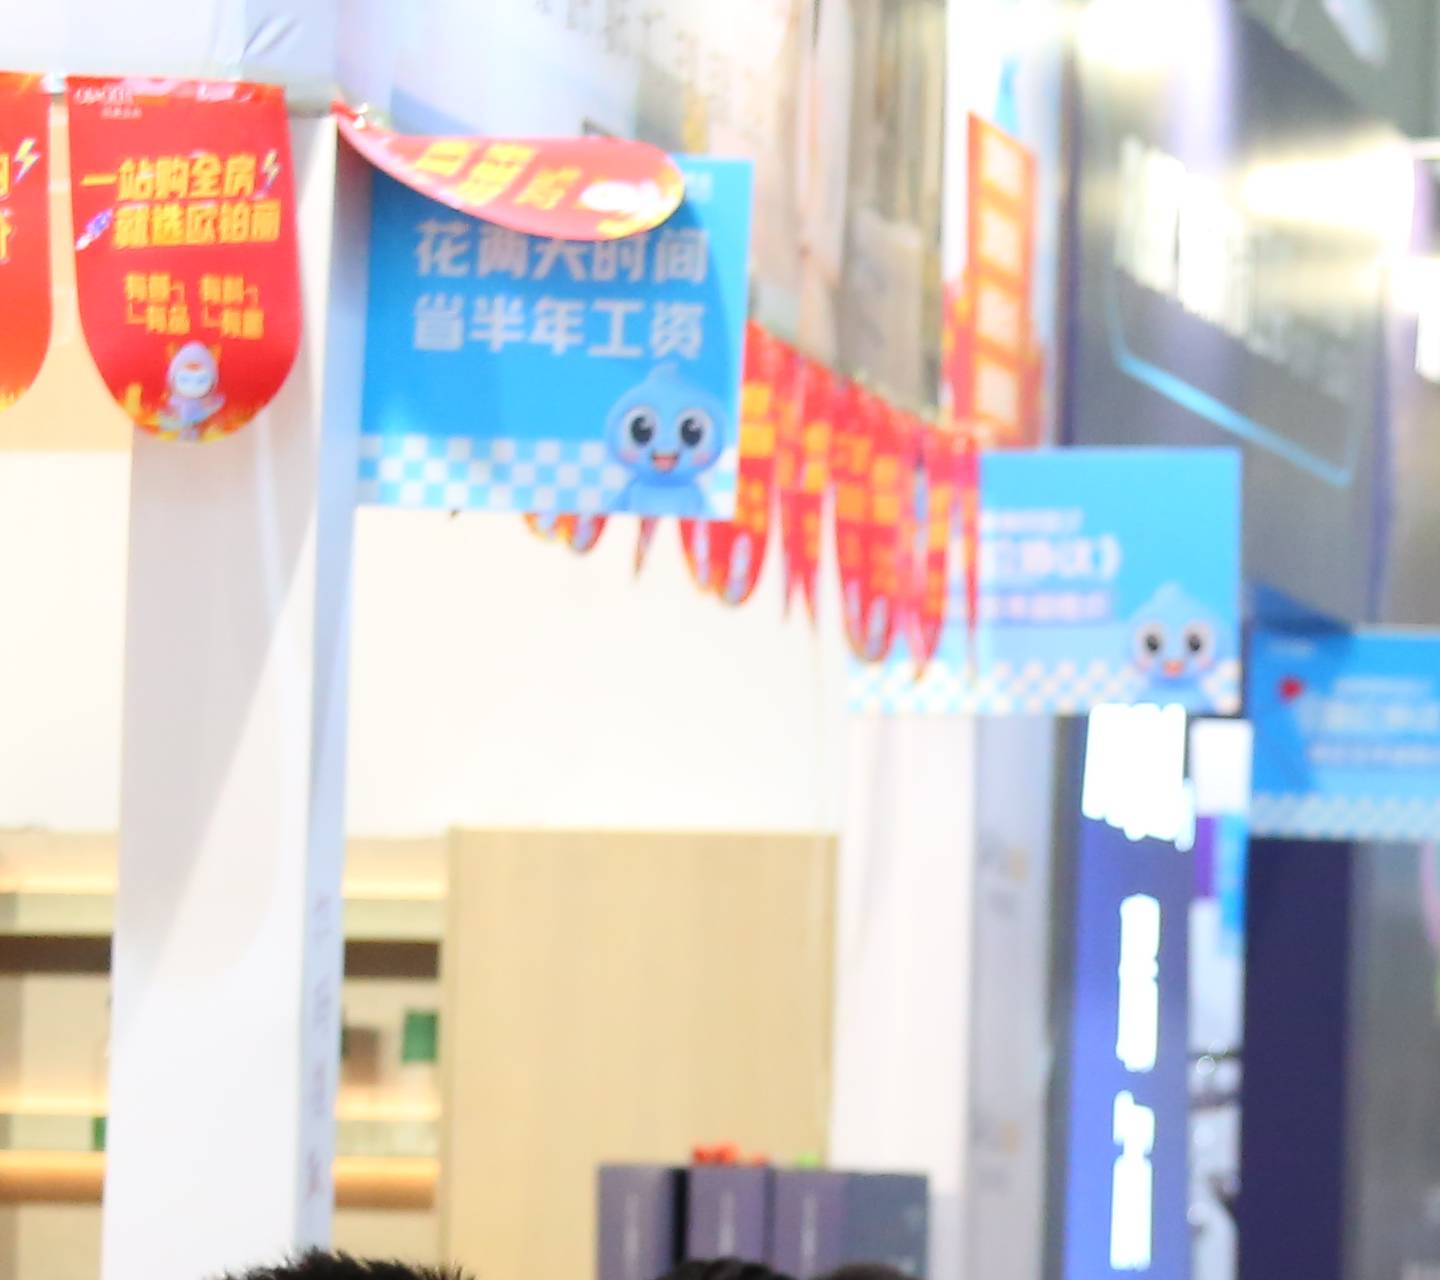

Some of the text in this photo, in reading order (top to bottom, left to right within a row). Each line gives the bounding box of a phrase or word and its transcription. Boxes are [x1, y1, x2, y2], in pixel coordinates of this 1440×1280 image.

[412, 291, 706, 361] 省半年工资
